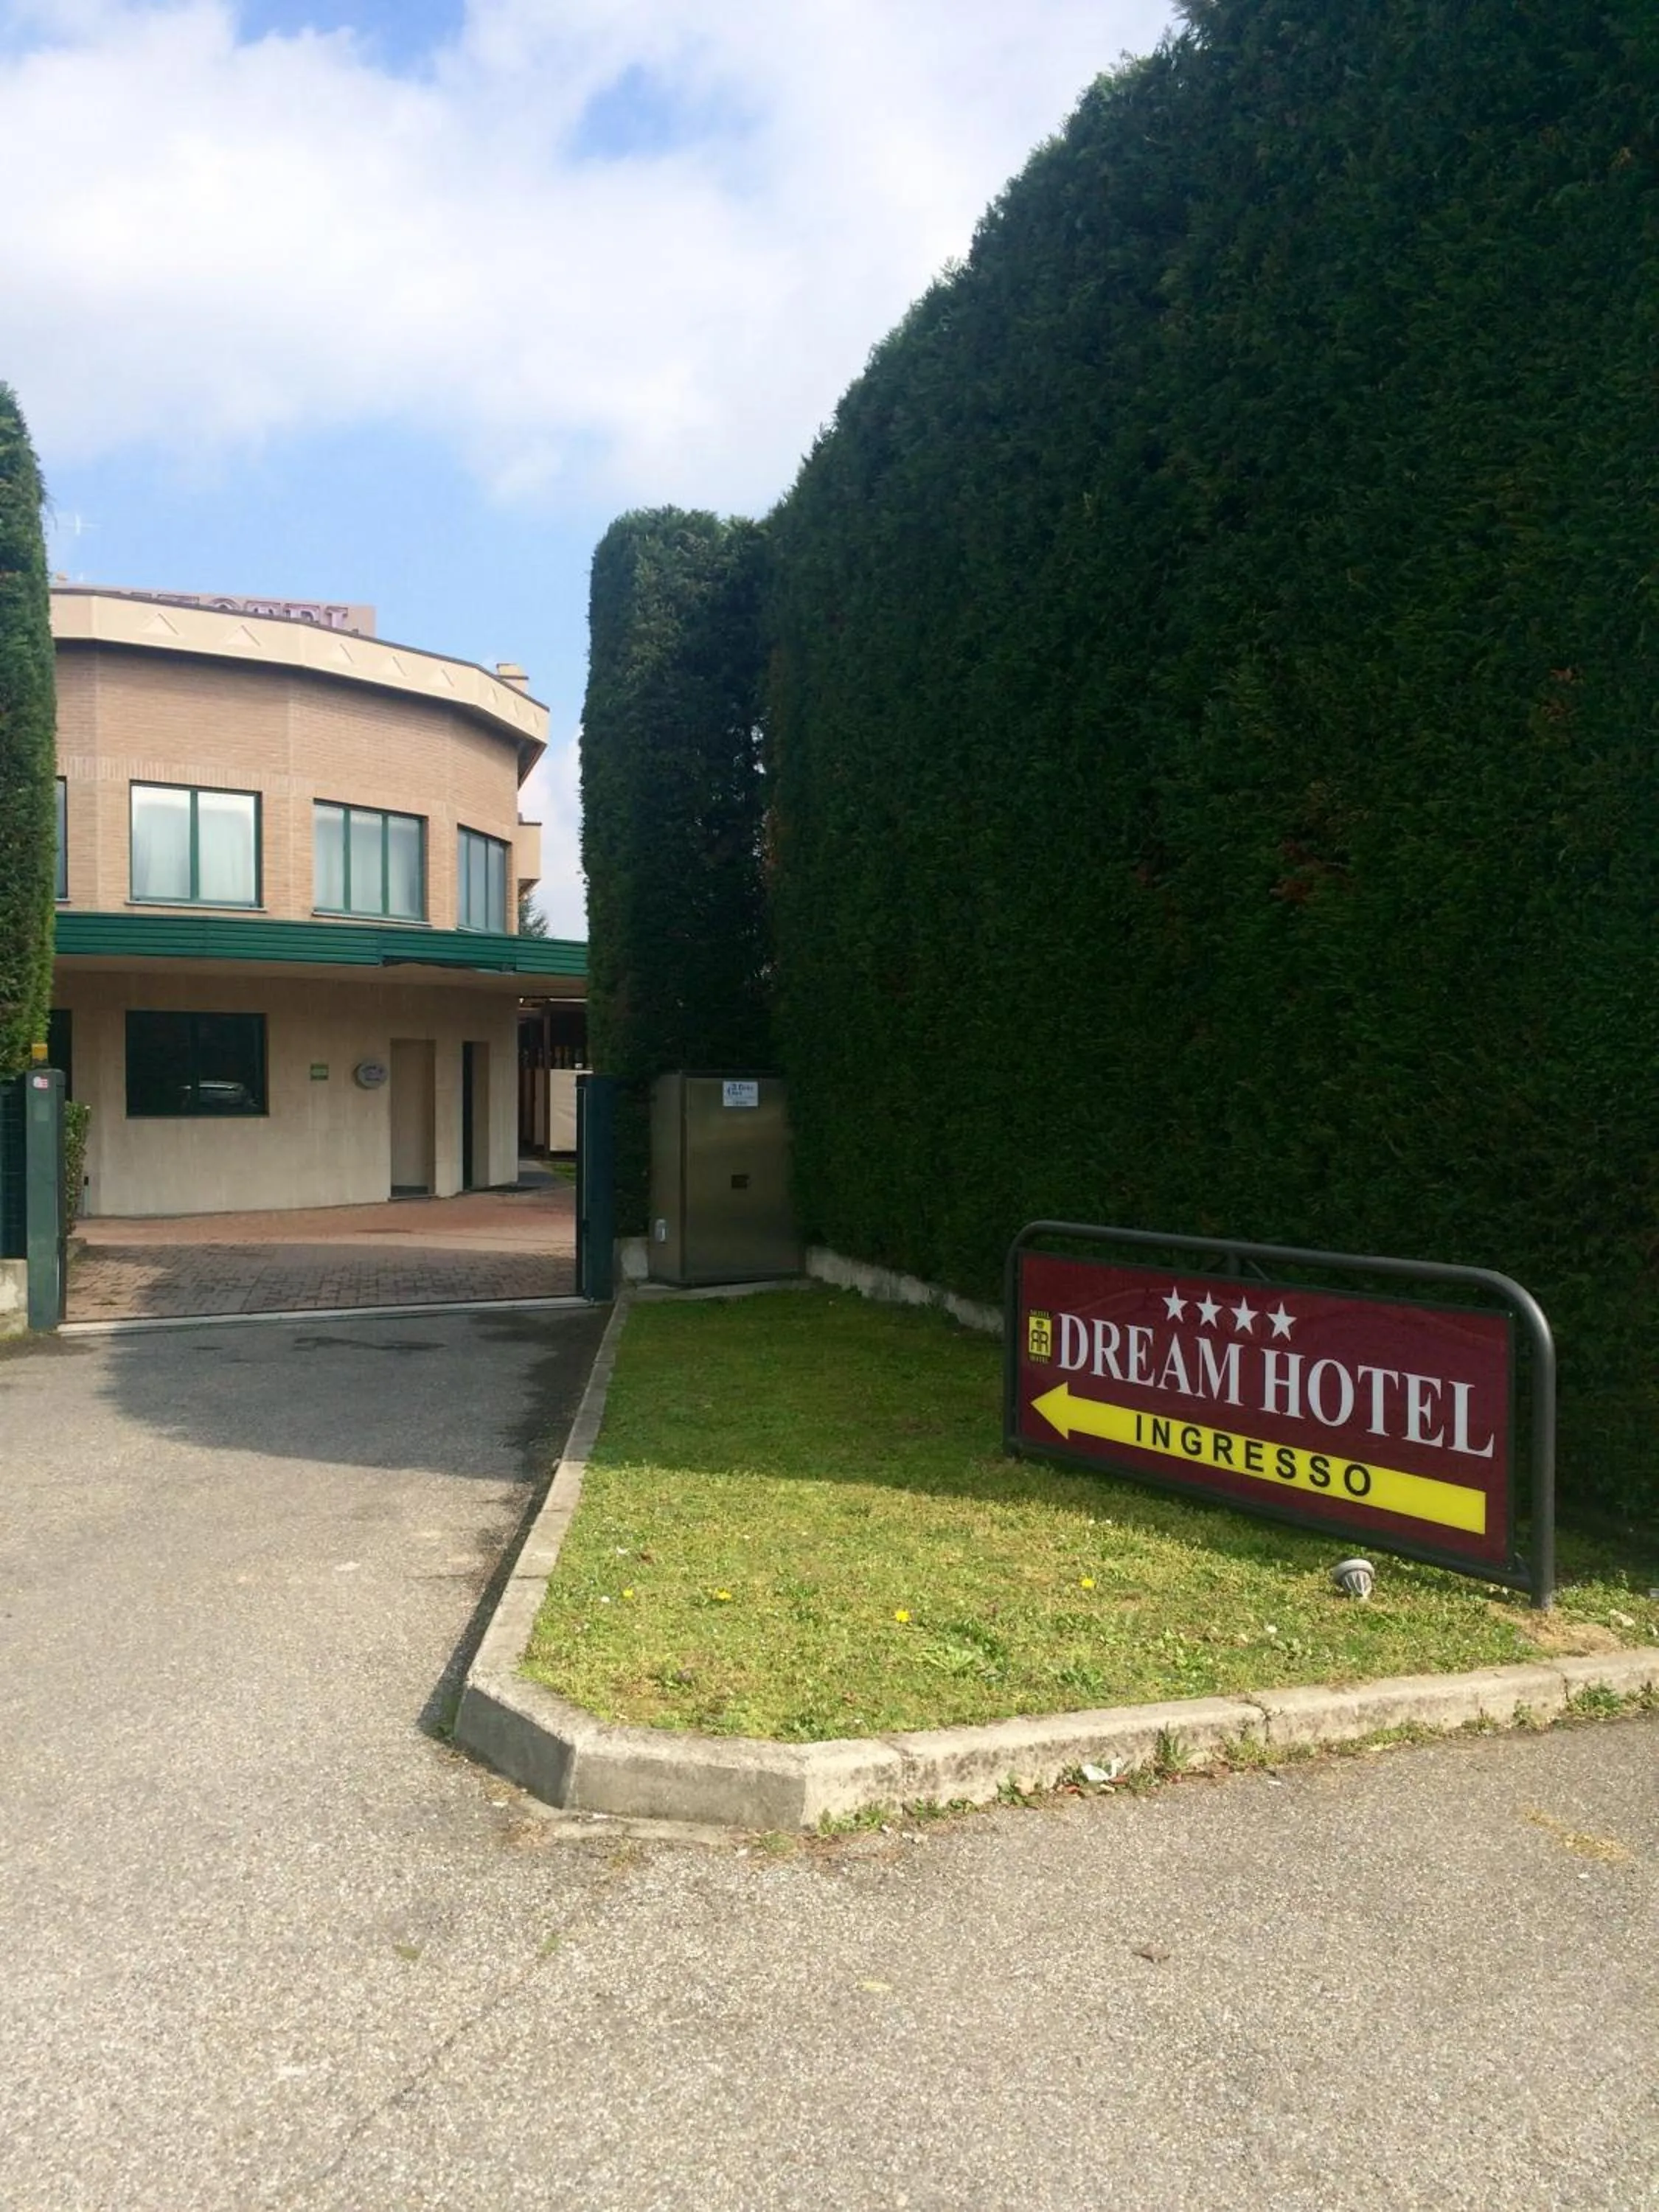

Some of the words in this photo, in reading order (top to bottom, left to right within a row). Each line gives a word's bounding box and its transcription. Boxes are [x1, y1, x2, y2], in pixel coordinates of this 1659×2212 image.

[1057, 1313, 1244, 1407] DREAM
[1260, 1349, 1495, 1458] HOTEL
[1136, 1414, 1371, 1497] INGRESSO
